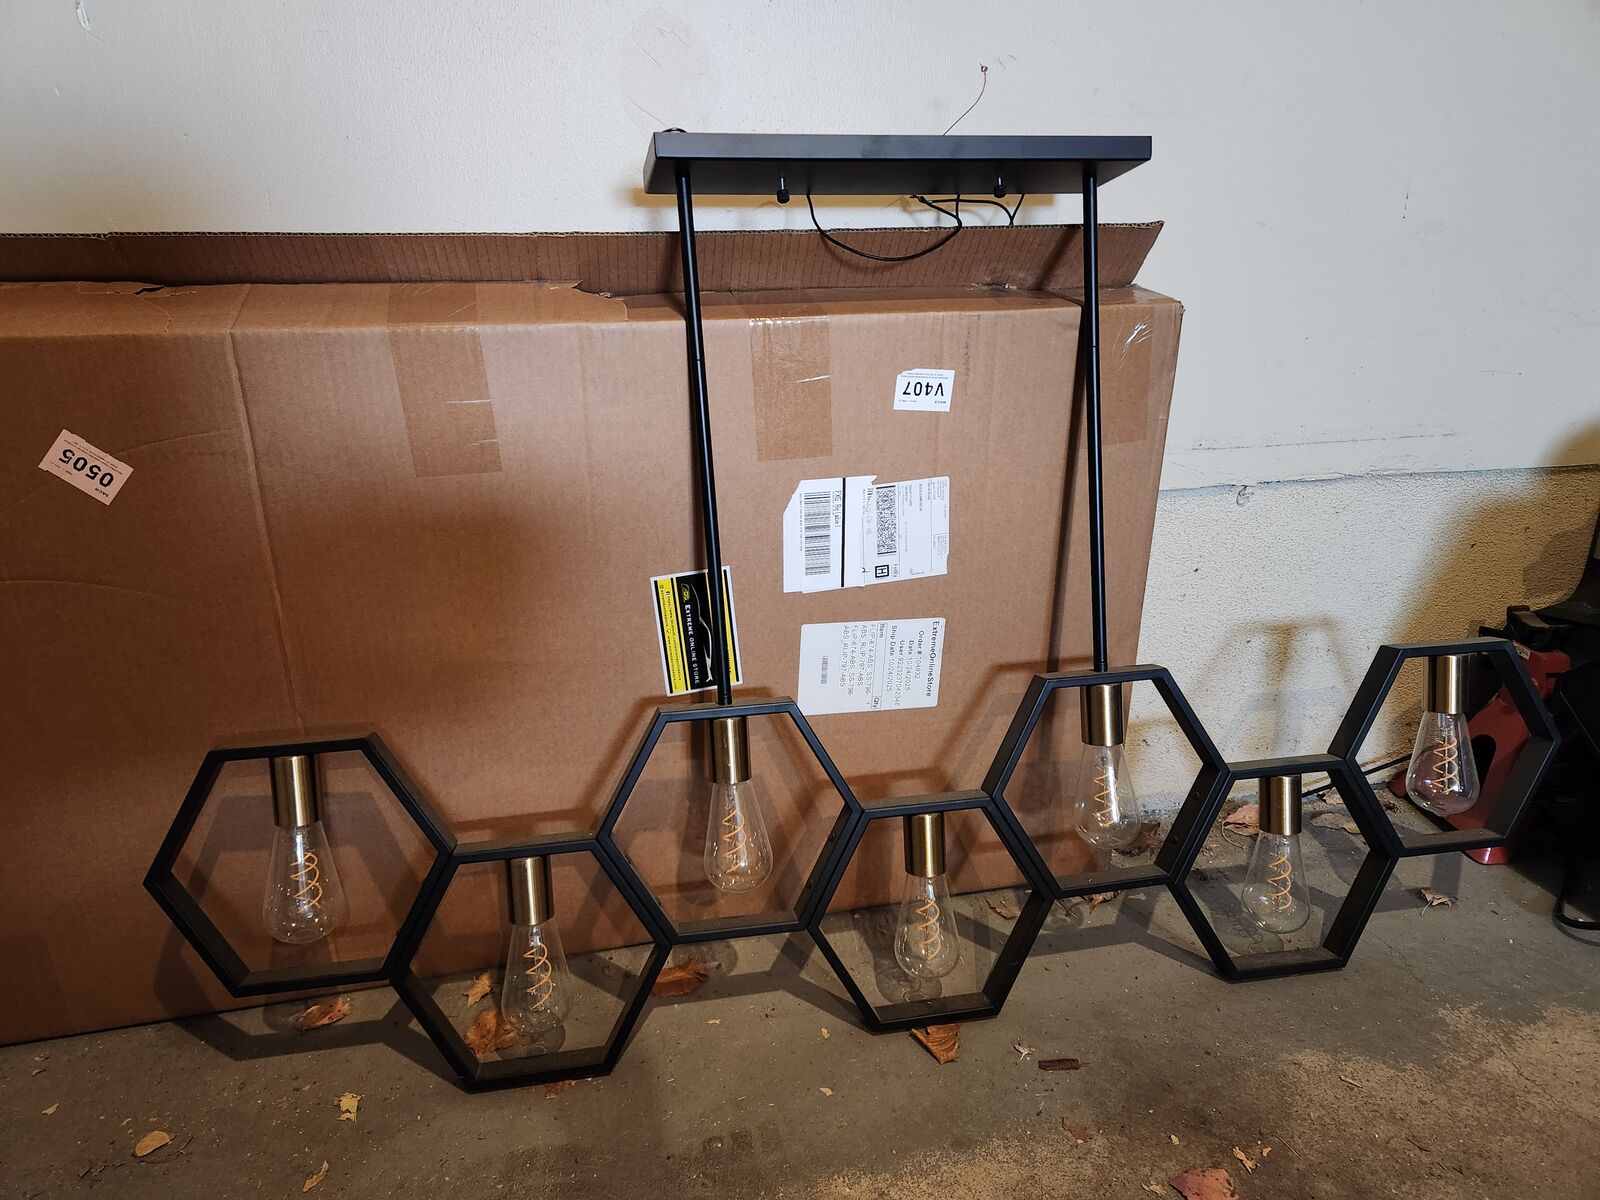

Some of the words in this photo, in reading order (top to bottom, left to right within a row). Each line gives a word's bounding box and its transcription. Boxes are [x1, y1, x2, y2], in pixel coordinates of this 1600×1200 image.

[902, 381, 944, 397] V407
[58, 449, 114, 488] 0505
[684, 604, 694, 636] EXTREME
[689, 637, 697, 662] ONLINE
[917, 630, 925, 649] Order
[914, 657, 922, 679] 104932
[926, 621, 940, 697] ExtremeOnlineStore
[692, 664, 700, 684] STORE
[886, 658, 895, 692] 10/24/2025
[904, 657, 913, 691] 10/24/2025
[872, 697, 880, 708] Qty
